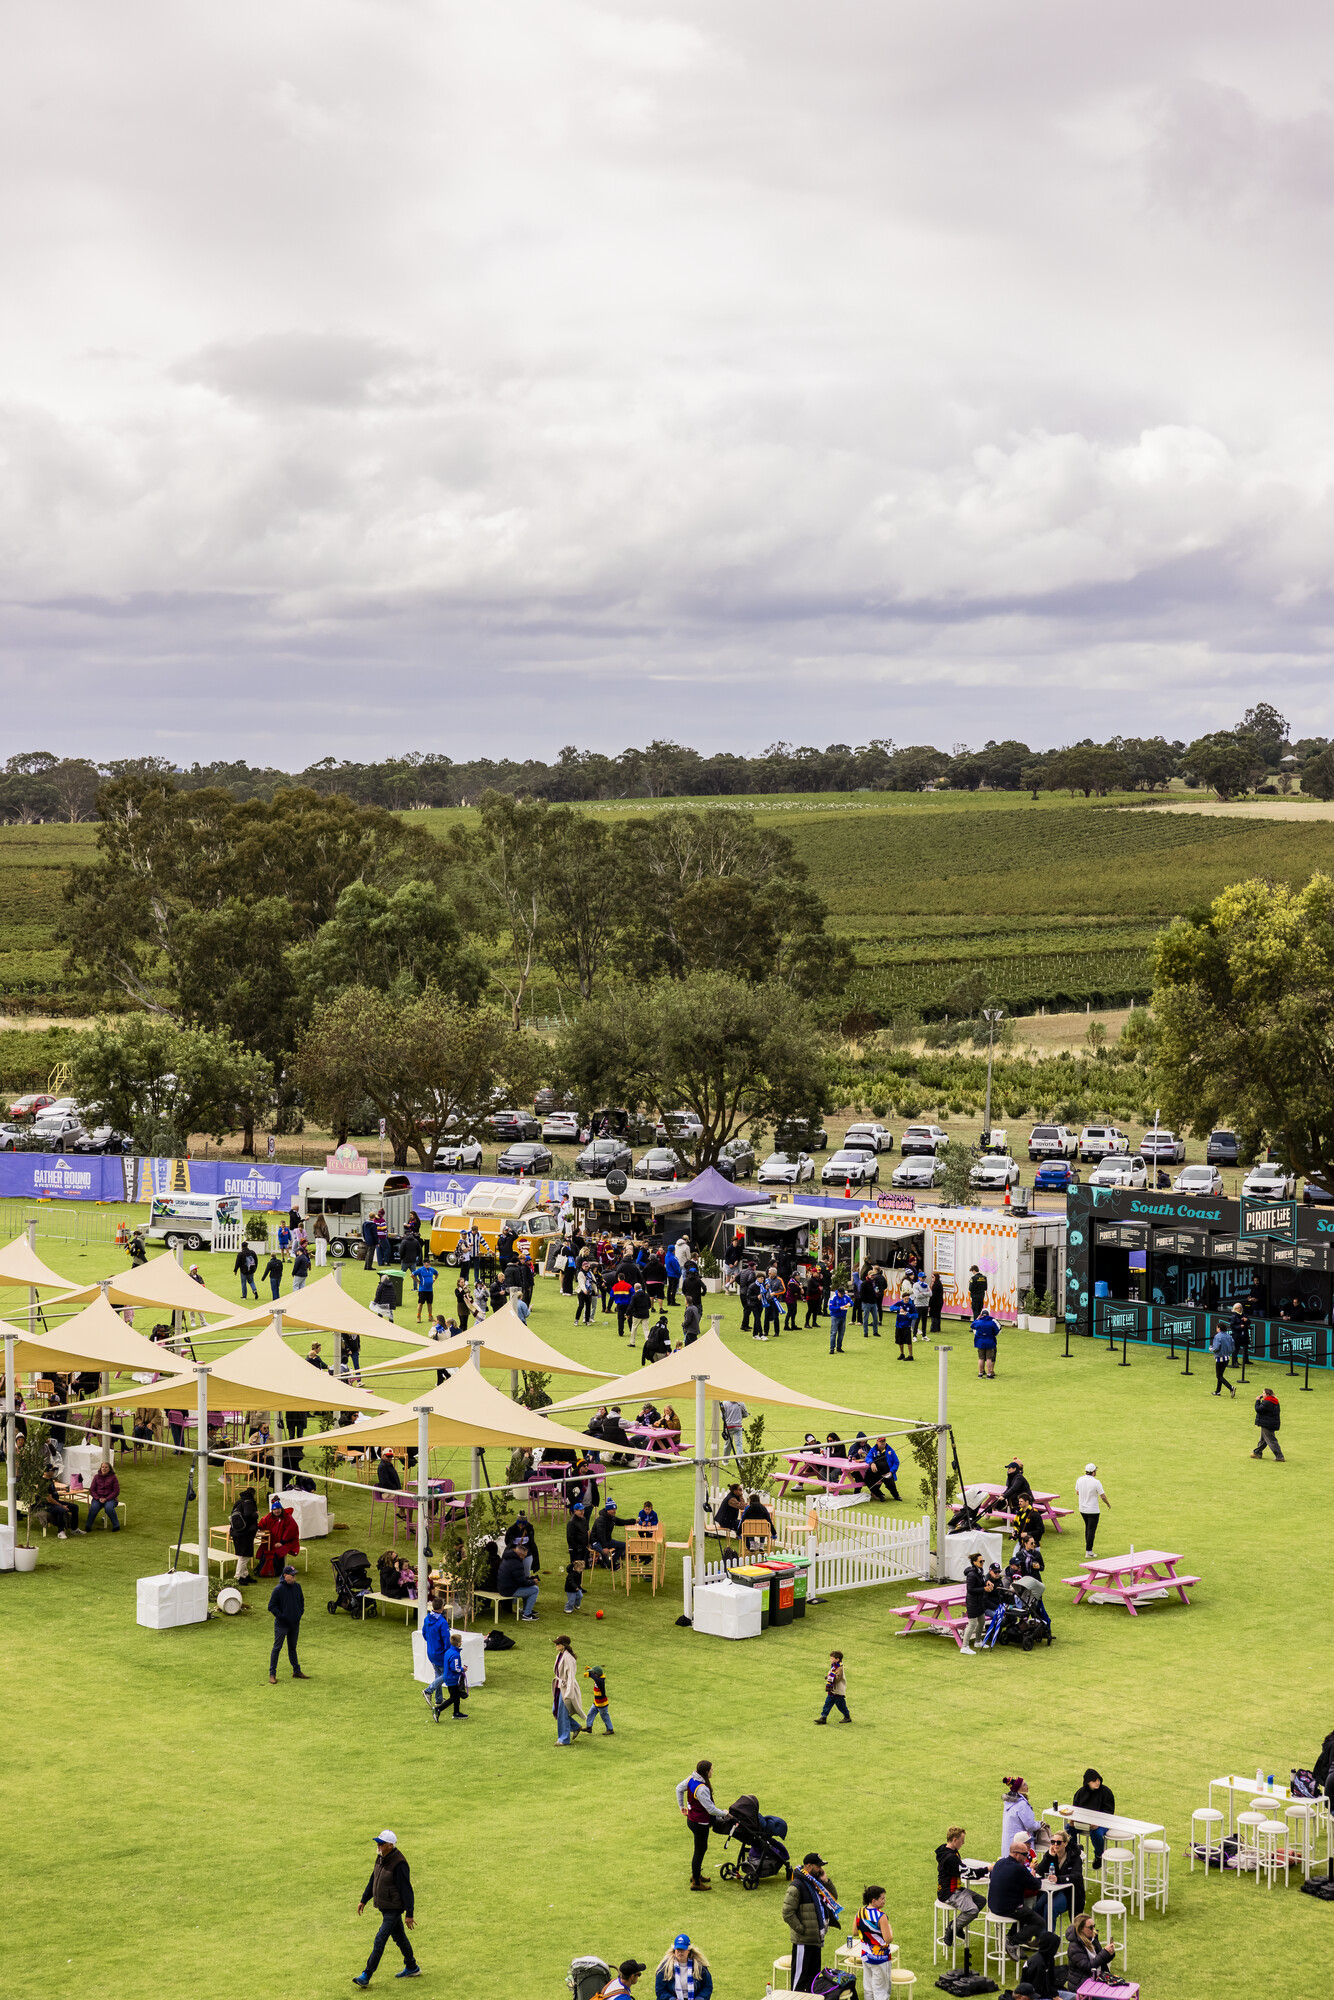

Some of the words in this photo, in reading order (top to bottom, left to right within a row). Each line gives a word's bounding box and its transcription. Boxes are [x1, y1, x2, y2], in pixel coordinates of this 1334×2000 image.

[344, 1162, 366, 1170] CREAM
[34, 1170, 63, 1184] GATHER
[64, 1171, 91, 1185] ROUND
[225, 1179, 256, 1193] GATHER
[257, 1180, 281, 1195] ROUND
[425, 1190, 454, 1204] GATHER
[1130, 1200, 1175, 1216] South
[1177, 1205, 1222, 1220] Coast
